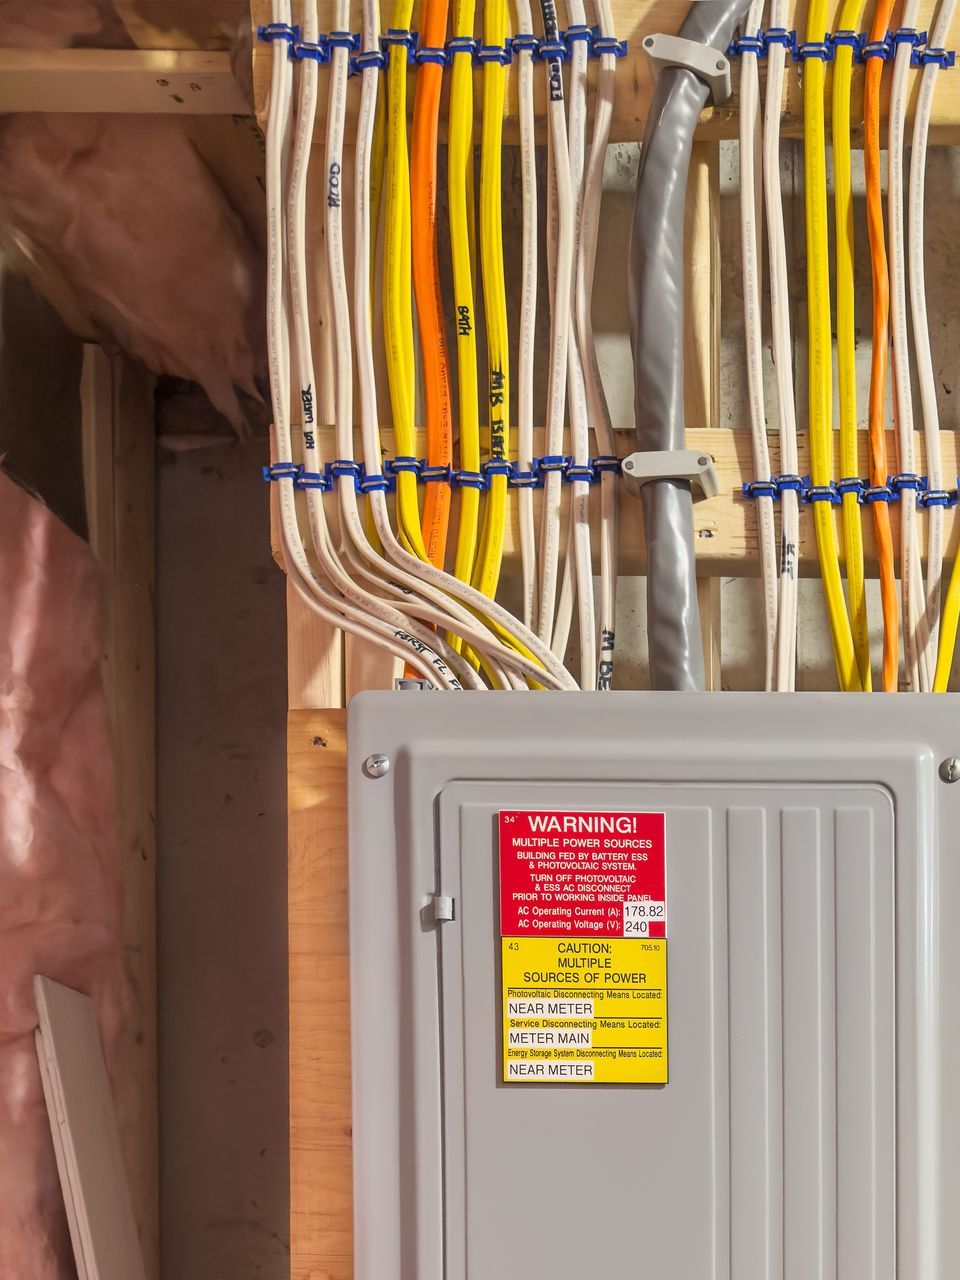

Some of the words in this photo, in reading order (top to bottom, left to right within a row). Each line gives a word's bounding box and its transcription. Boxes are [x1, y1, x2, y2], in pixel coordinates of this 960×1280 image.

[455, 306, 470, 336] BATH
[302, 384, 314, 424] WATER
[528, 816, 637, 833] WARNING!
[512, 838, 559, 847] MULTIPLE
[563, 839, 600, 847] POWER
[604, 839, 652, 848] SOURCES
[517, 852, 556, 860] BUILDING
[530, 874, 552, 882] TURN
[532, 907, 571, 917] Operating
[575, 907, 604, 916] Current
[608, 908, 620, 917] (A):
[625, 906, 663, 917] 178.82
[518, 920, 529, 928] AC
[532, 920, 571, 930] Operating
[574, 921, 603, 931] Voltage
[607, 921, 620, 930] (V):
[625, 921, 647, 932] 240
[558, 944, 612, 953] CAUTION:
[558, 958, 611, 968] MULTIPLE
[524, 972, 579, 982] SOURCES
[584, 973, 599, 982] OF
[604, 973, 646, 983] POWER
[508, 990, 550, 998] Photovoltaic
[554, 991, 604, 1000] Disconnecting
[509, 1003, 544, 1014] NEAR
[548, 1003, 592, 1014] METER
[542, 1020, 597, 1030] Disconnecting
[510, 1033, 554, 1043] METER
[558, 1033, 589, 1043] MAIN
[508, 1049, 528, 1058] Energy
[530, 1049, 551, 1059] Storage
[554, 1050, 574, 1059] System
[577, 1050, 616, 1059] Disconnecting
[510, 1064, 544, 1075] NEAR
[548, 1065, 592, 1075] METER
